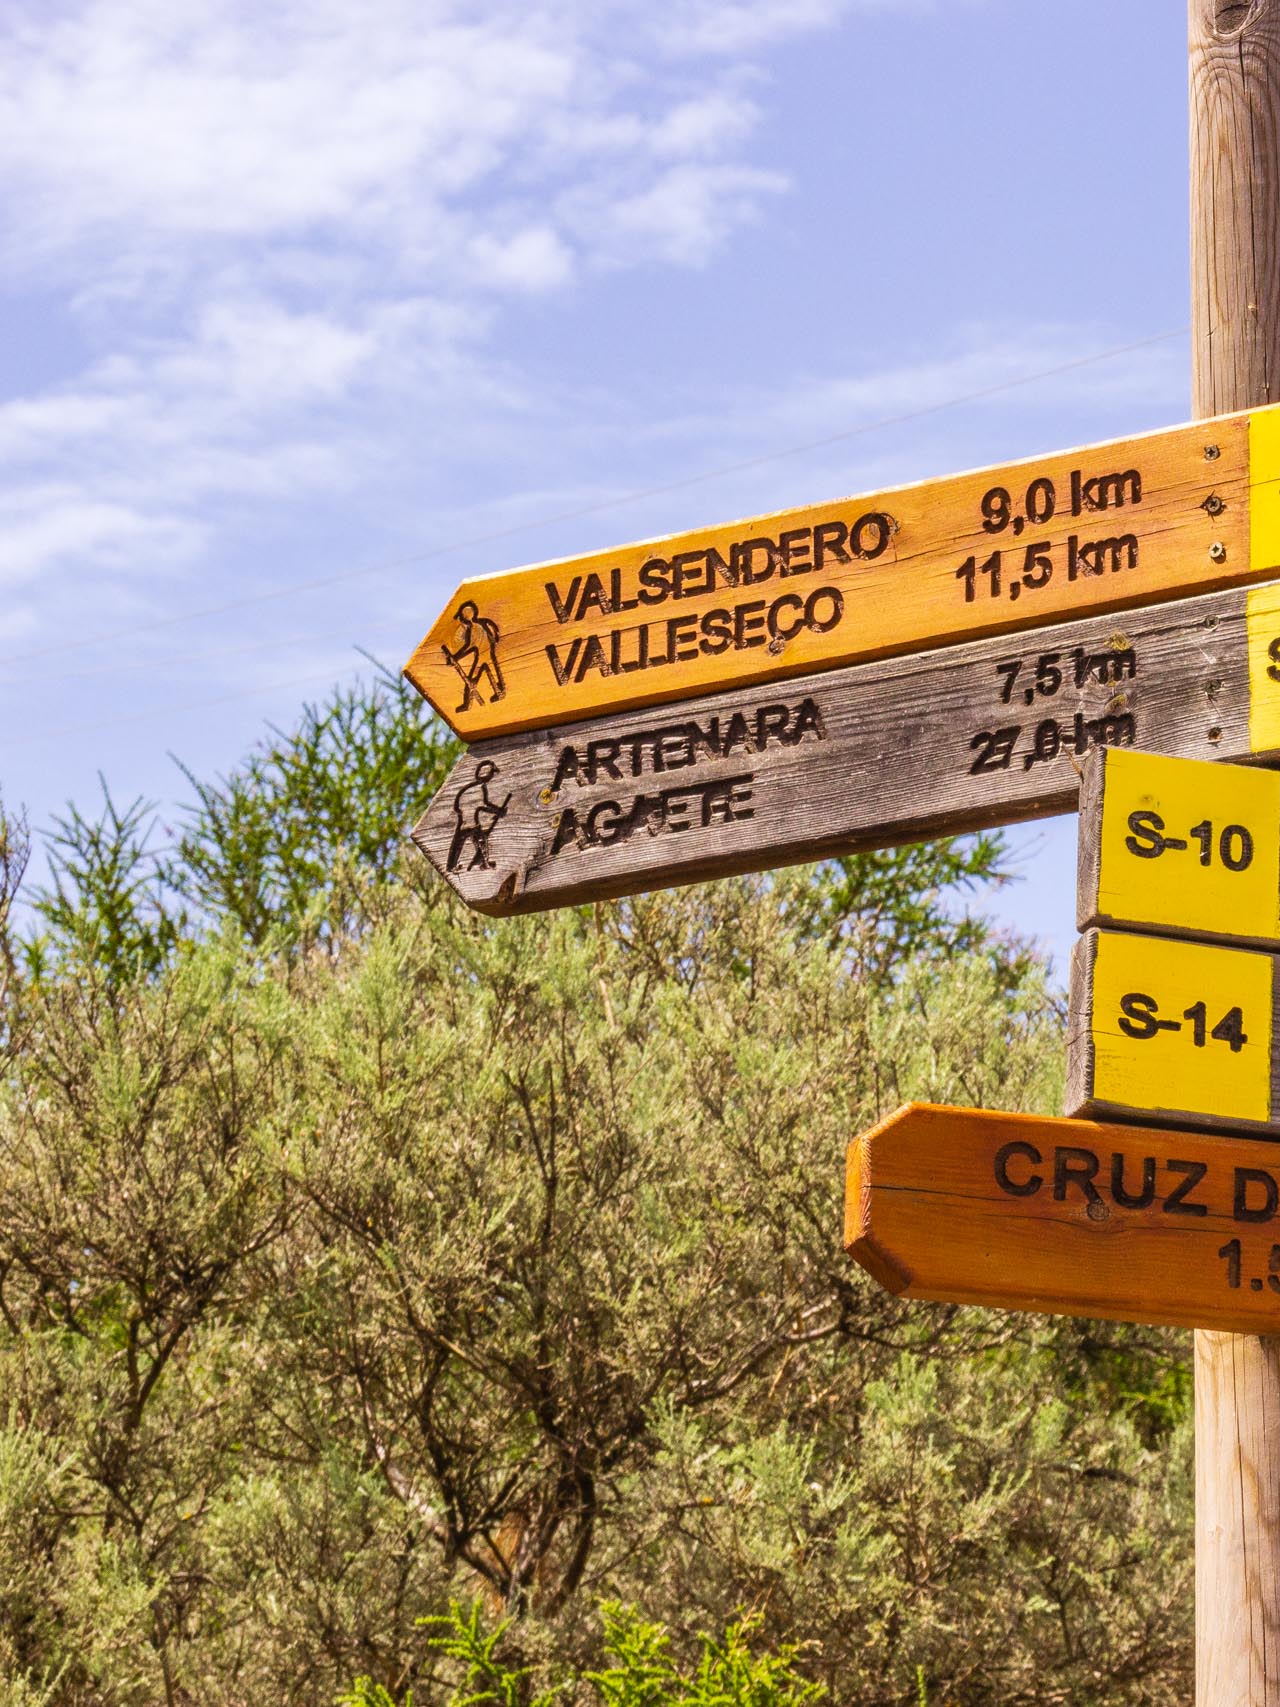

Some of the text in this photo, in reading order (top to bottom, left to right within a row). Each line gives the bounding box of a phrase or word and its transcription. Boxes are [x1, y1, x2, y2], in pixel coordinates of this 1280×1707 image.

[980, 468, 1142, 535] 9,0 km
[545, 512, 895, 624] VALSENDERO
[955, 531, 1139, 602] 11,5 km
[545, 586, 845, 686] VALLESECO
[996, 646, 1137, 706] 7,5 km
[553, 698, 827, 791] ARTENARA
[1073, 711, 1137, 755] km
[550, 774, 756, 855] AGAETE
[1124, 810, 1254, 873] S-10
[1118, 992, 1248, 1053] S-14
[993, 1140, 1208, 1218] CRUZ
